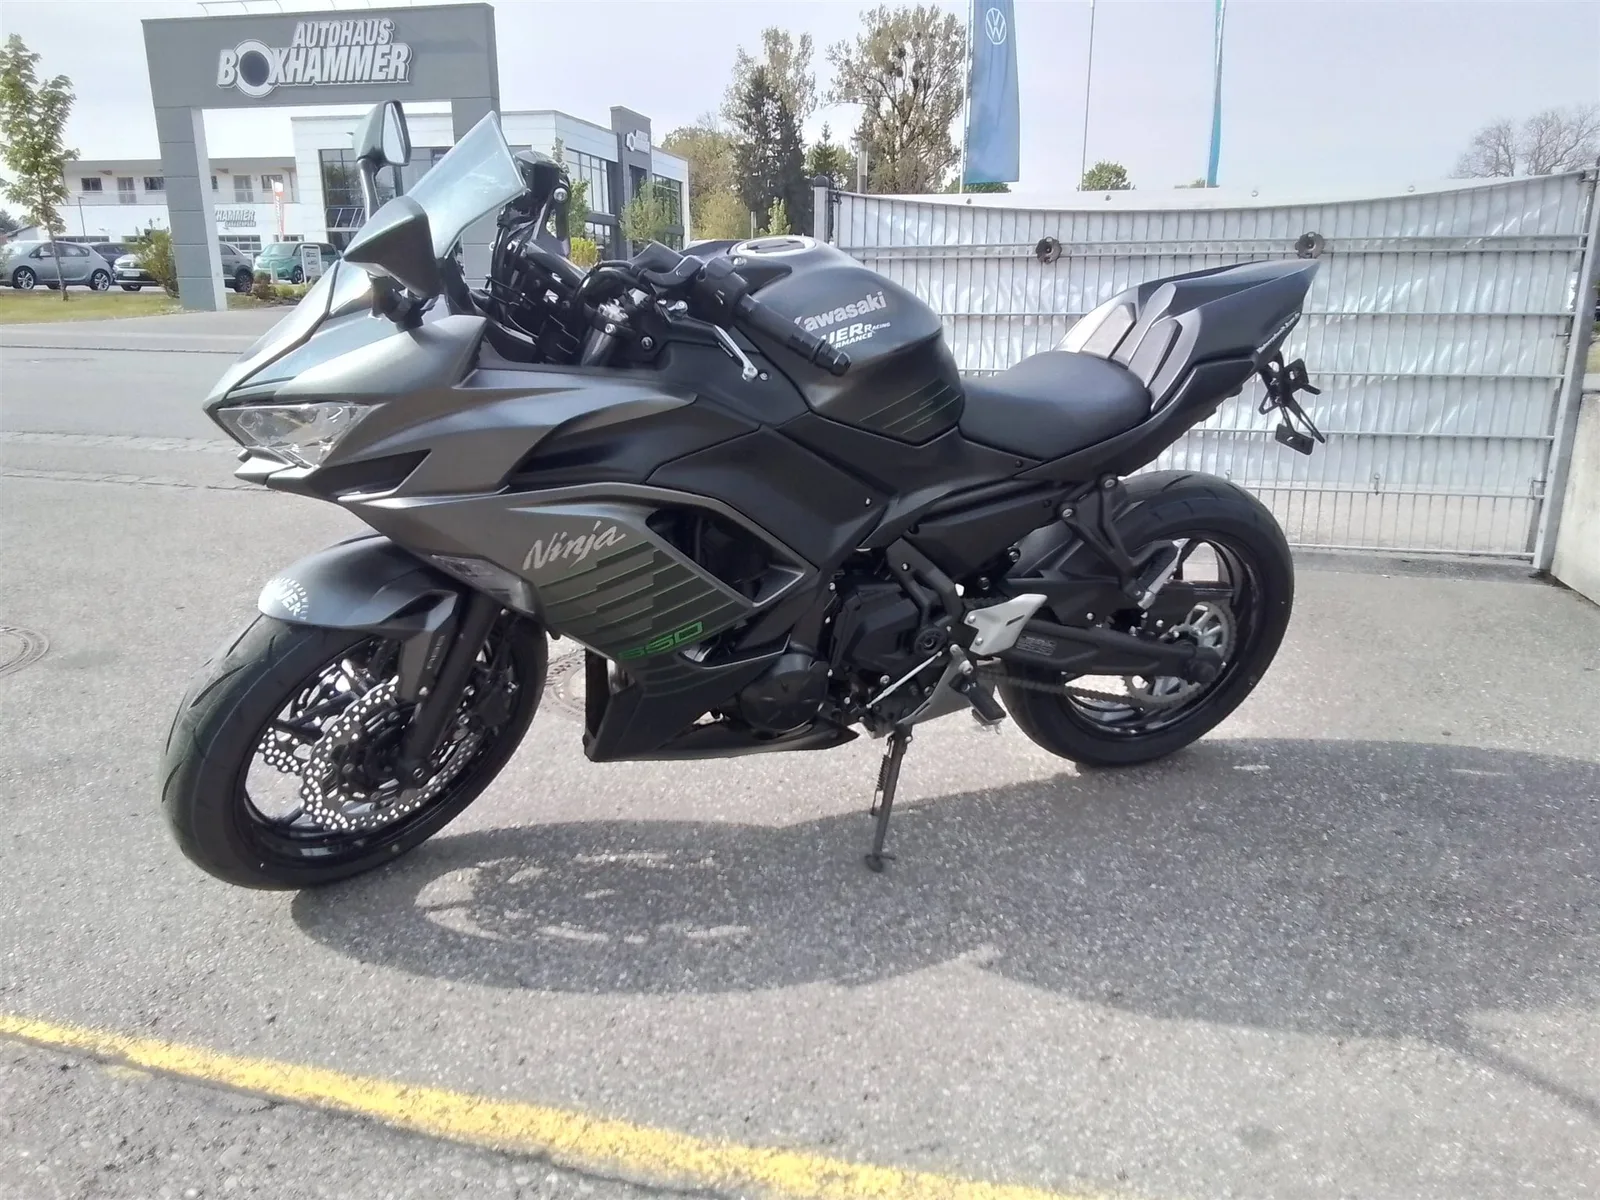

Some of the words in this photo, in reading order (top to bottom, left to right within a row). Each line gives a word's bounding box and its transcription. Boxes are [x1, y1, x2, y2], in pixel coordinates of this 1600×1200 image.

[292, 18, 395, 48] AUTOHAUS
[217, 39, 412, 98] BOXHAMMER
[794, 291, 887, 332] awasaki
[523, 520, 627, 570] Ninja
[617, 620, 703, 660] 650
